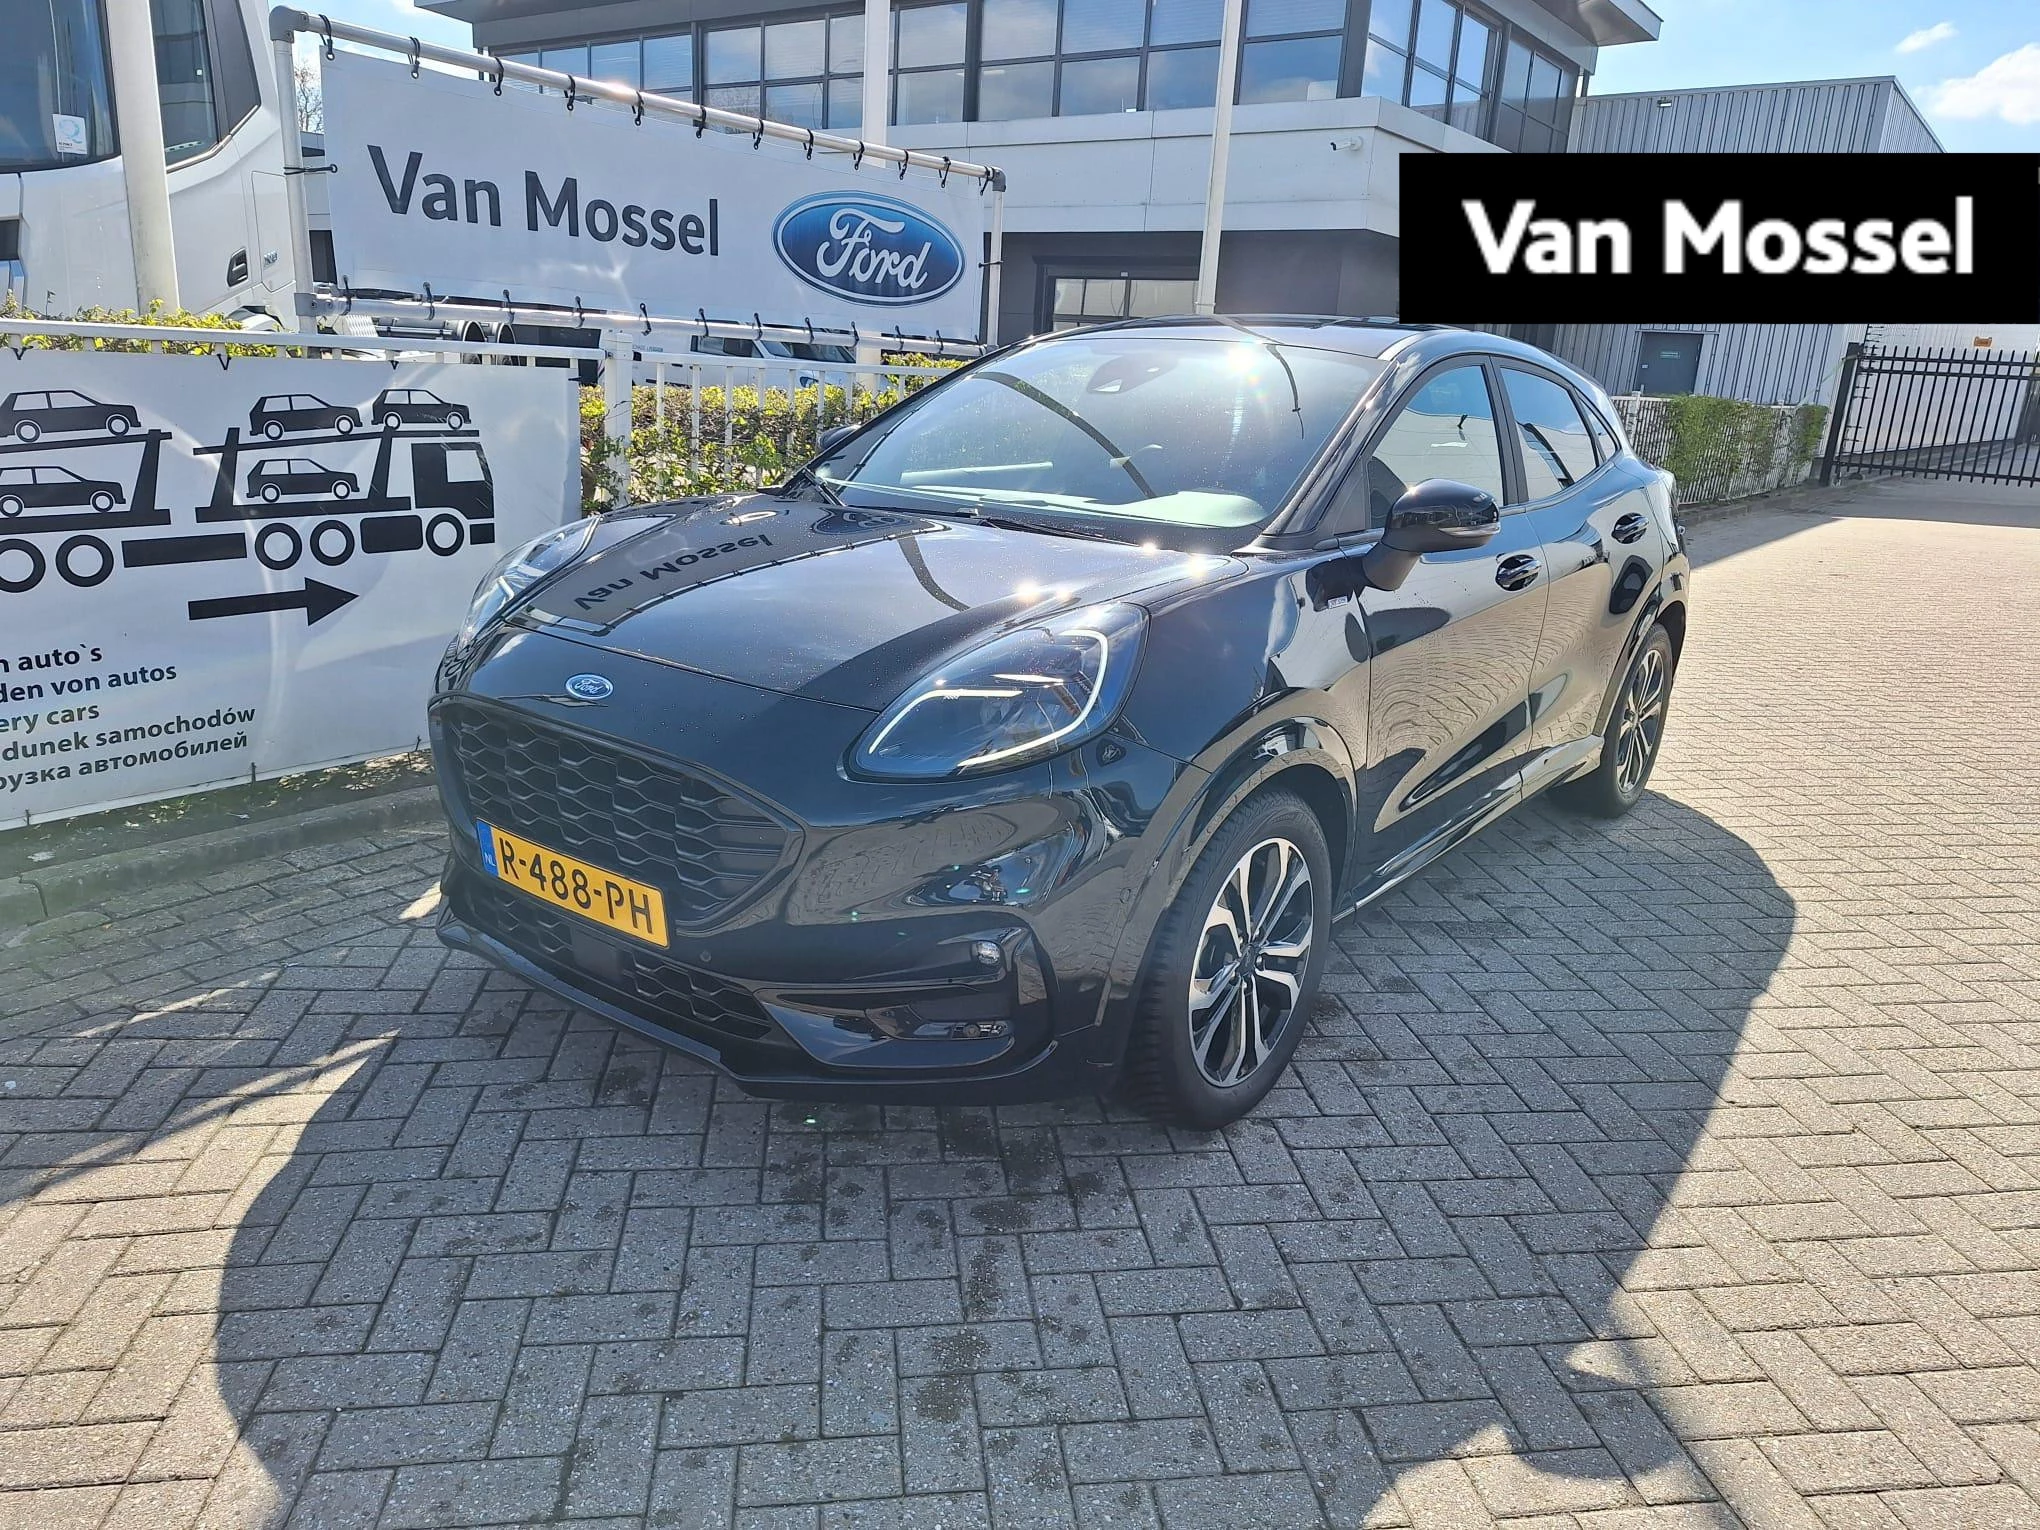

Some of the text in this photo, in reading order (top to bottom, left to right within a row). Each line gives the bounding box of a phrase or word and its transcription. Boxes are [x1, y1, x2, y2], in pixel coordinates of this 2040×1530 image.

[367, 144, 719, 257] Van Mossel
[816, 208, 932, 289] Ford
[51, 675, 100, 695] von
[108, 665, 177, 688] autos
[2, 707, 256, 761] dunek samochodów
[46, 704, 100, 725] cars
[78, 731, 248, 776] автомобилей
[484, 853, 496, 867] NL
[499, 836, 653, 934] R-488-PH
